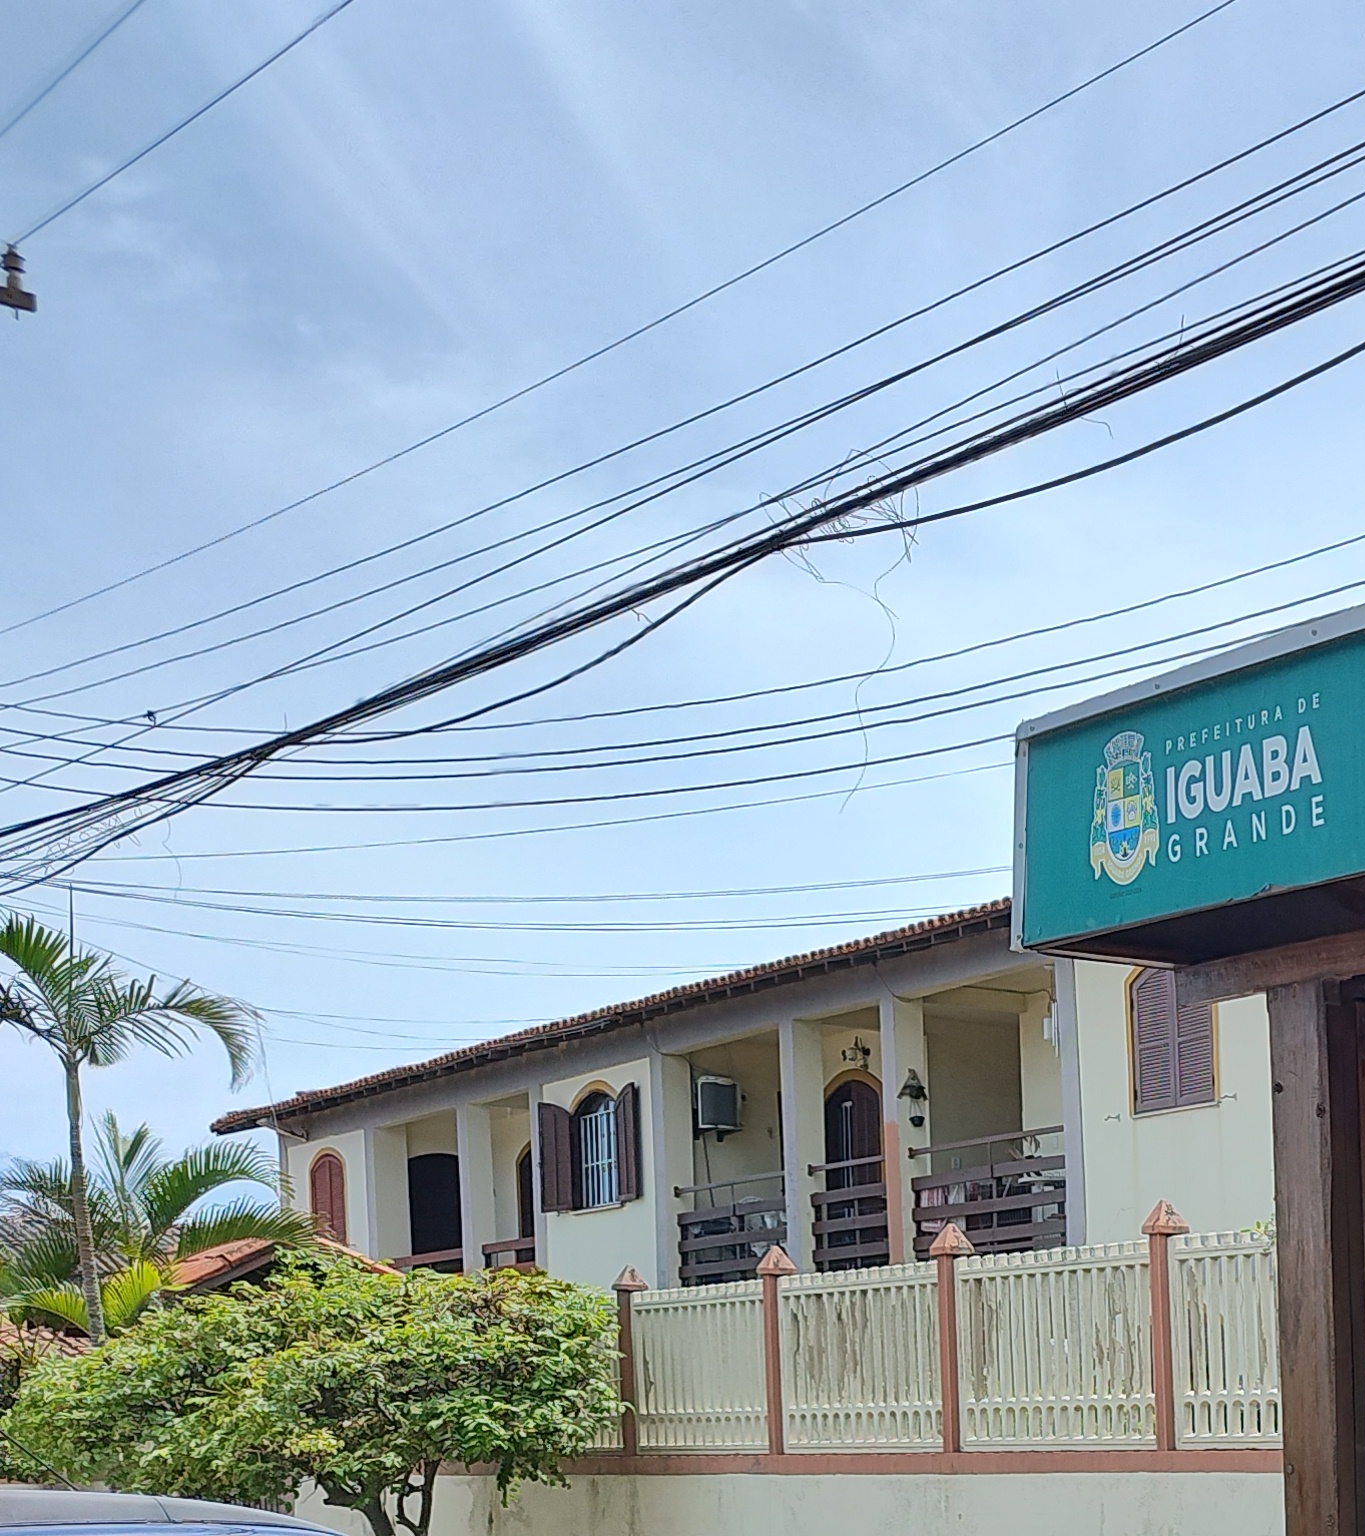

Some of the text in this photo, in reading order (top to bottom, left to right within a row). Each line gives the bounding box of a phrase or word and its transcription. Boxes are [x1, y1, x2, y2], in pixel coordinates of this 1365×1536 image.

[1165, 692, 1321, 755] PREFEITURA DE
[1166, 724, 1323, 825] IGUABA
[1167, 795, 1325, 863] GRANDE
